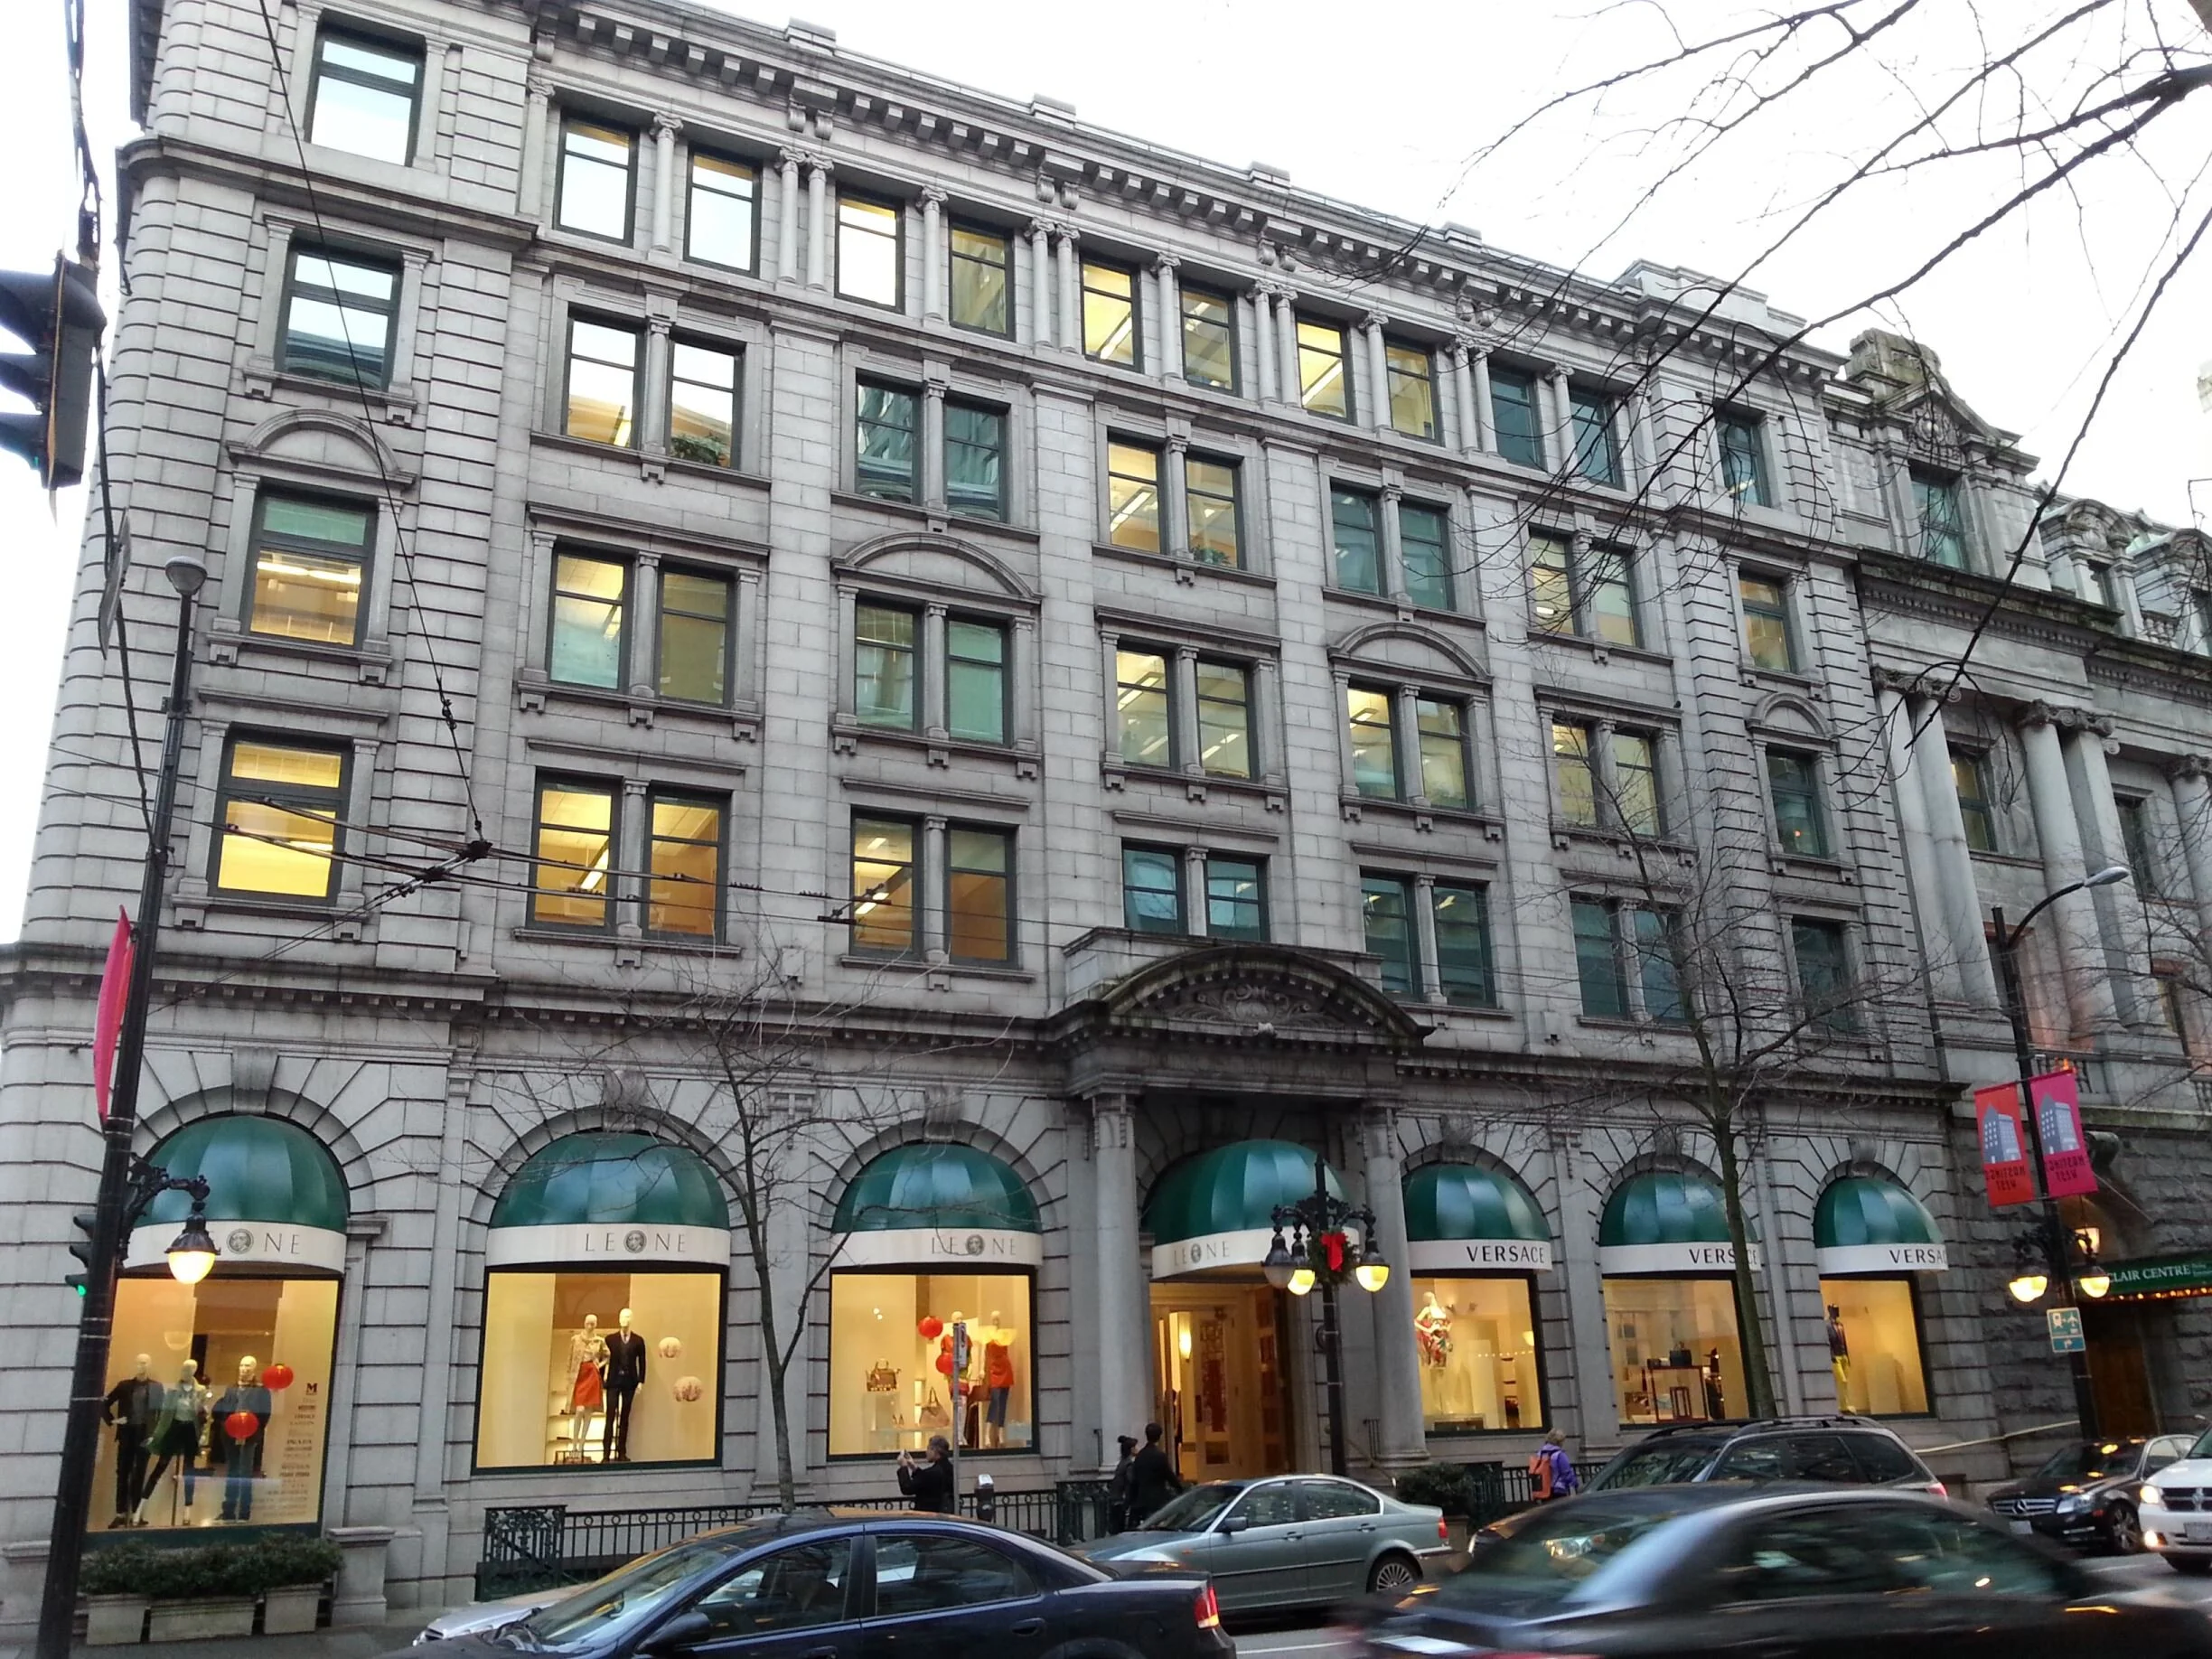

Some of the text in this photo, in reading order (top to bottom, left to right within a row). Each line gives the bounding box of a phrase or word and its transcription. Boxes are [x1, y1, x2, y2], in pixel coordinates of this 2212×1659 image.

[585, 1230, 687, 1254] LEONE
[1466, 1245, 1545, 1263] VERSACE
[1688, 1248, 1757, 1265] VERSE
[2142, 1264, 2191, 1279] CENTRE
